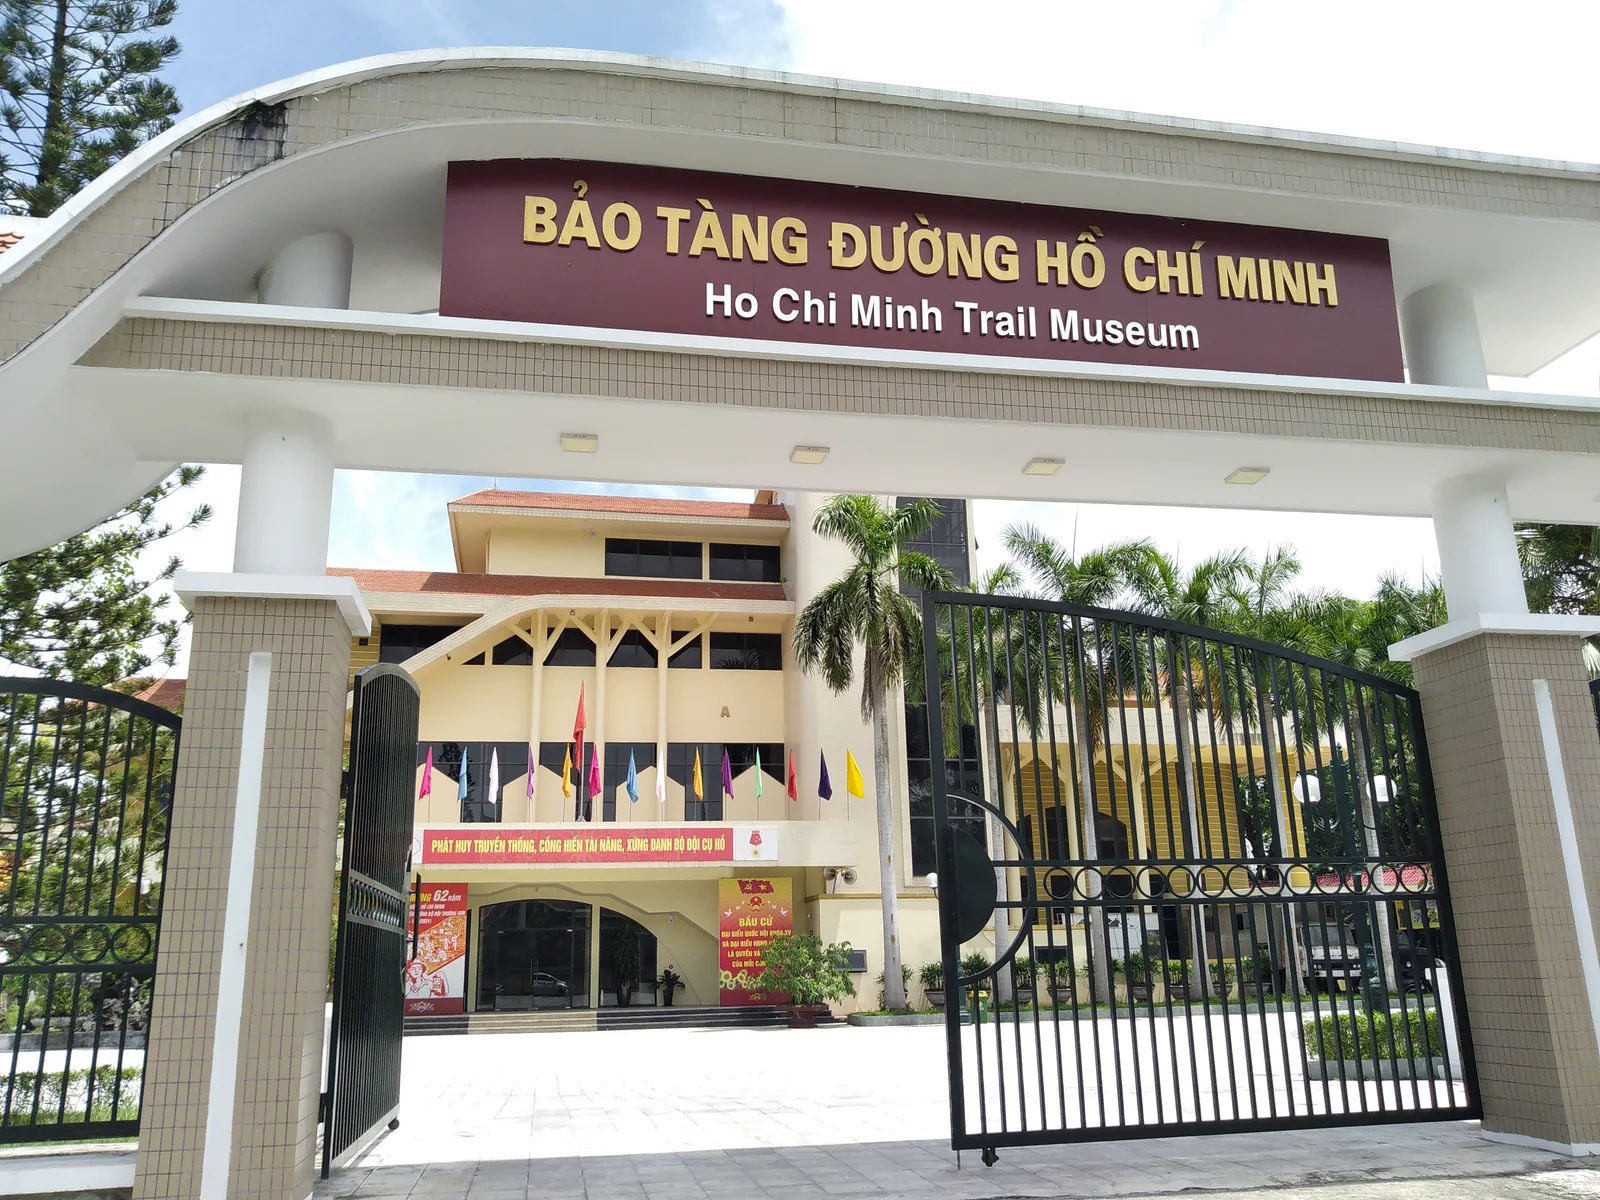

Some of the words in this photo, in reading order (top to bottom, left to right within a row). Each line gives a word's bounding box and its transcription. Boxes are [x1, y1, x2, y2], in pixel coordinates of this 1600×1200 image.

[524, 180, 642, 251] BẢO
[656, 198, 808, 265] TÀNG
[828, 213, 1020, 283] ĐƯỜNG
[1036, 225, 1107, 290] HỒ
[1123, 240, 1206, 296] CHÍ
[1217, 255, 1339, 307] MINH
[705, 282, 758, 320] Ho
[772, 287, 837, 325] Chi
[851, 293, 943, 332] Minh
[954, 300, 1037, 339] Trail
[1050, 308, 1200, 350] Museum
[431, 837, 454, 853] PHÁT
[455, 839, 472, 853] HUY
[474, 835, 505, 853] TRUYỀN
[508, 835, 537, 854] THỐNG,
[539, 835, 562, 853] CỐNG
[563, 835, 583, 853] HIẾN
[585, 836, 598, 852] TÀI
[600, 836, 625, 853] NĂNG,
[626, 835, 649, 852] XỨNG
[650, 837, 672, 852] DANH
[674, 835, 685, 854] BỘ
[686, 835, 700, 854] ĐỘI
[702, 837, 713, 854] CỤ
[433, 889, 449, 902] 62
[739, 915, 757, 927] BẦU
[760, 914, 774, 926] CỬ
